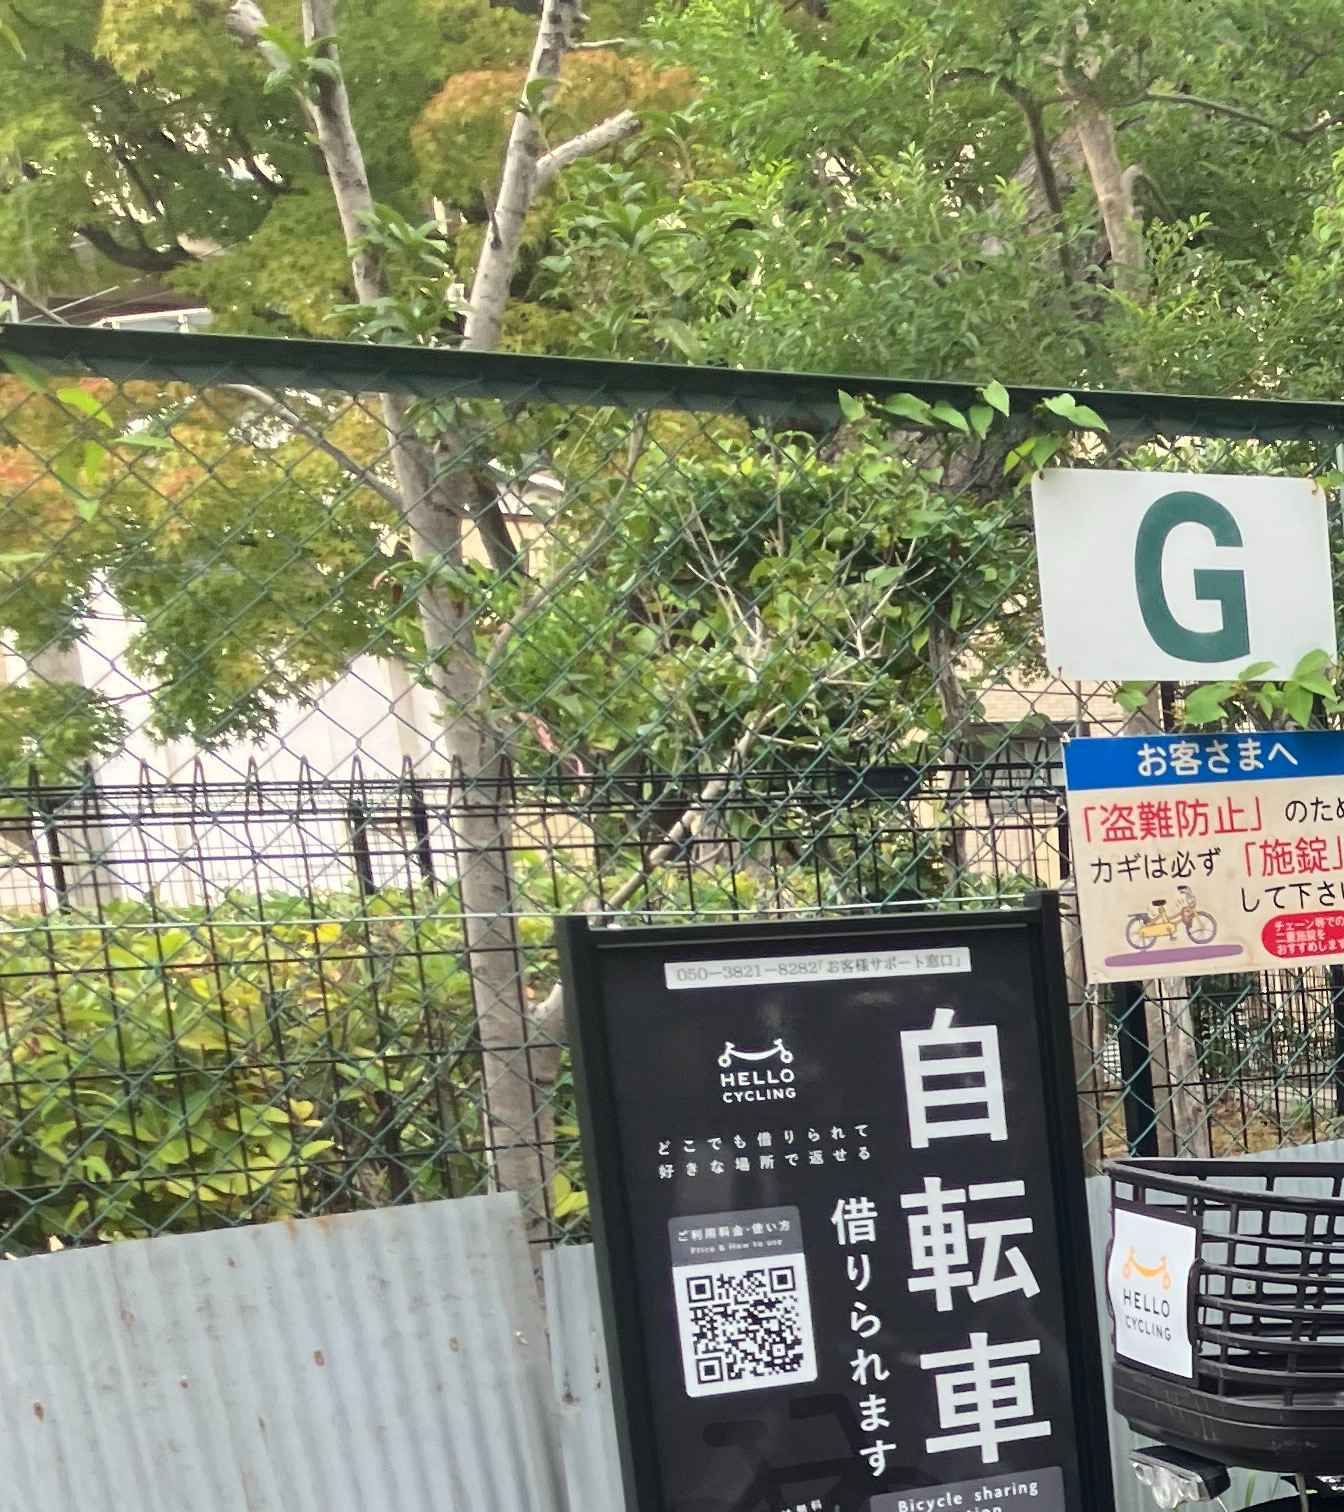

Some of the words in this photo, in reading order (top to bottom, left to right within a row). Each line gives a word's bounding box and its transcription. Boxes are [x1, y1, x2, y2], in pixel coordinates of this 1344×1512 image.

[1135, 490, 1250, 663] G
[1137, 741, 1298, 777] お客さまへ
[1081, 796, 1263, 844] 「盗難防止」
[1090, 848, 1221, 885] カギは必ず
[1244, 835, 1344, 877] 「施錠」
[720, 1068, 795, 1087] HELLO
[722, 1087, 797, 1103] CYCLING
[658, 1124, 869, 1156] どこでも借りられて
[658, 1146, 871, 1180] 好きな場所で返せる
[900, 1007, 1052, 1464] 自転車
[1123, 1288, 1170, 1318] HELLO
[831, 1196, 897, 1478] 借りられます
[1125, 1315, 1171, 1342] CYCLING
[974, 1480, 1039, 1501] sharing
